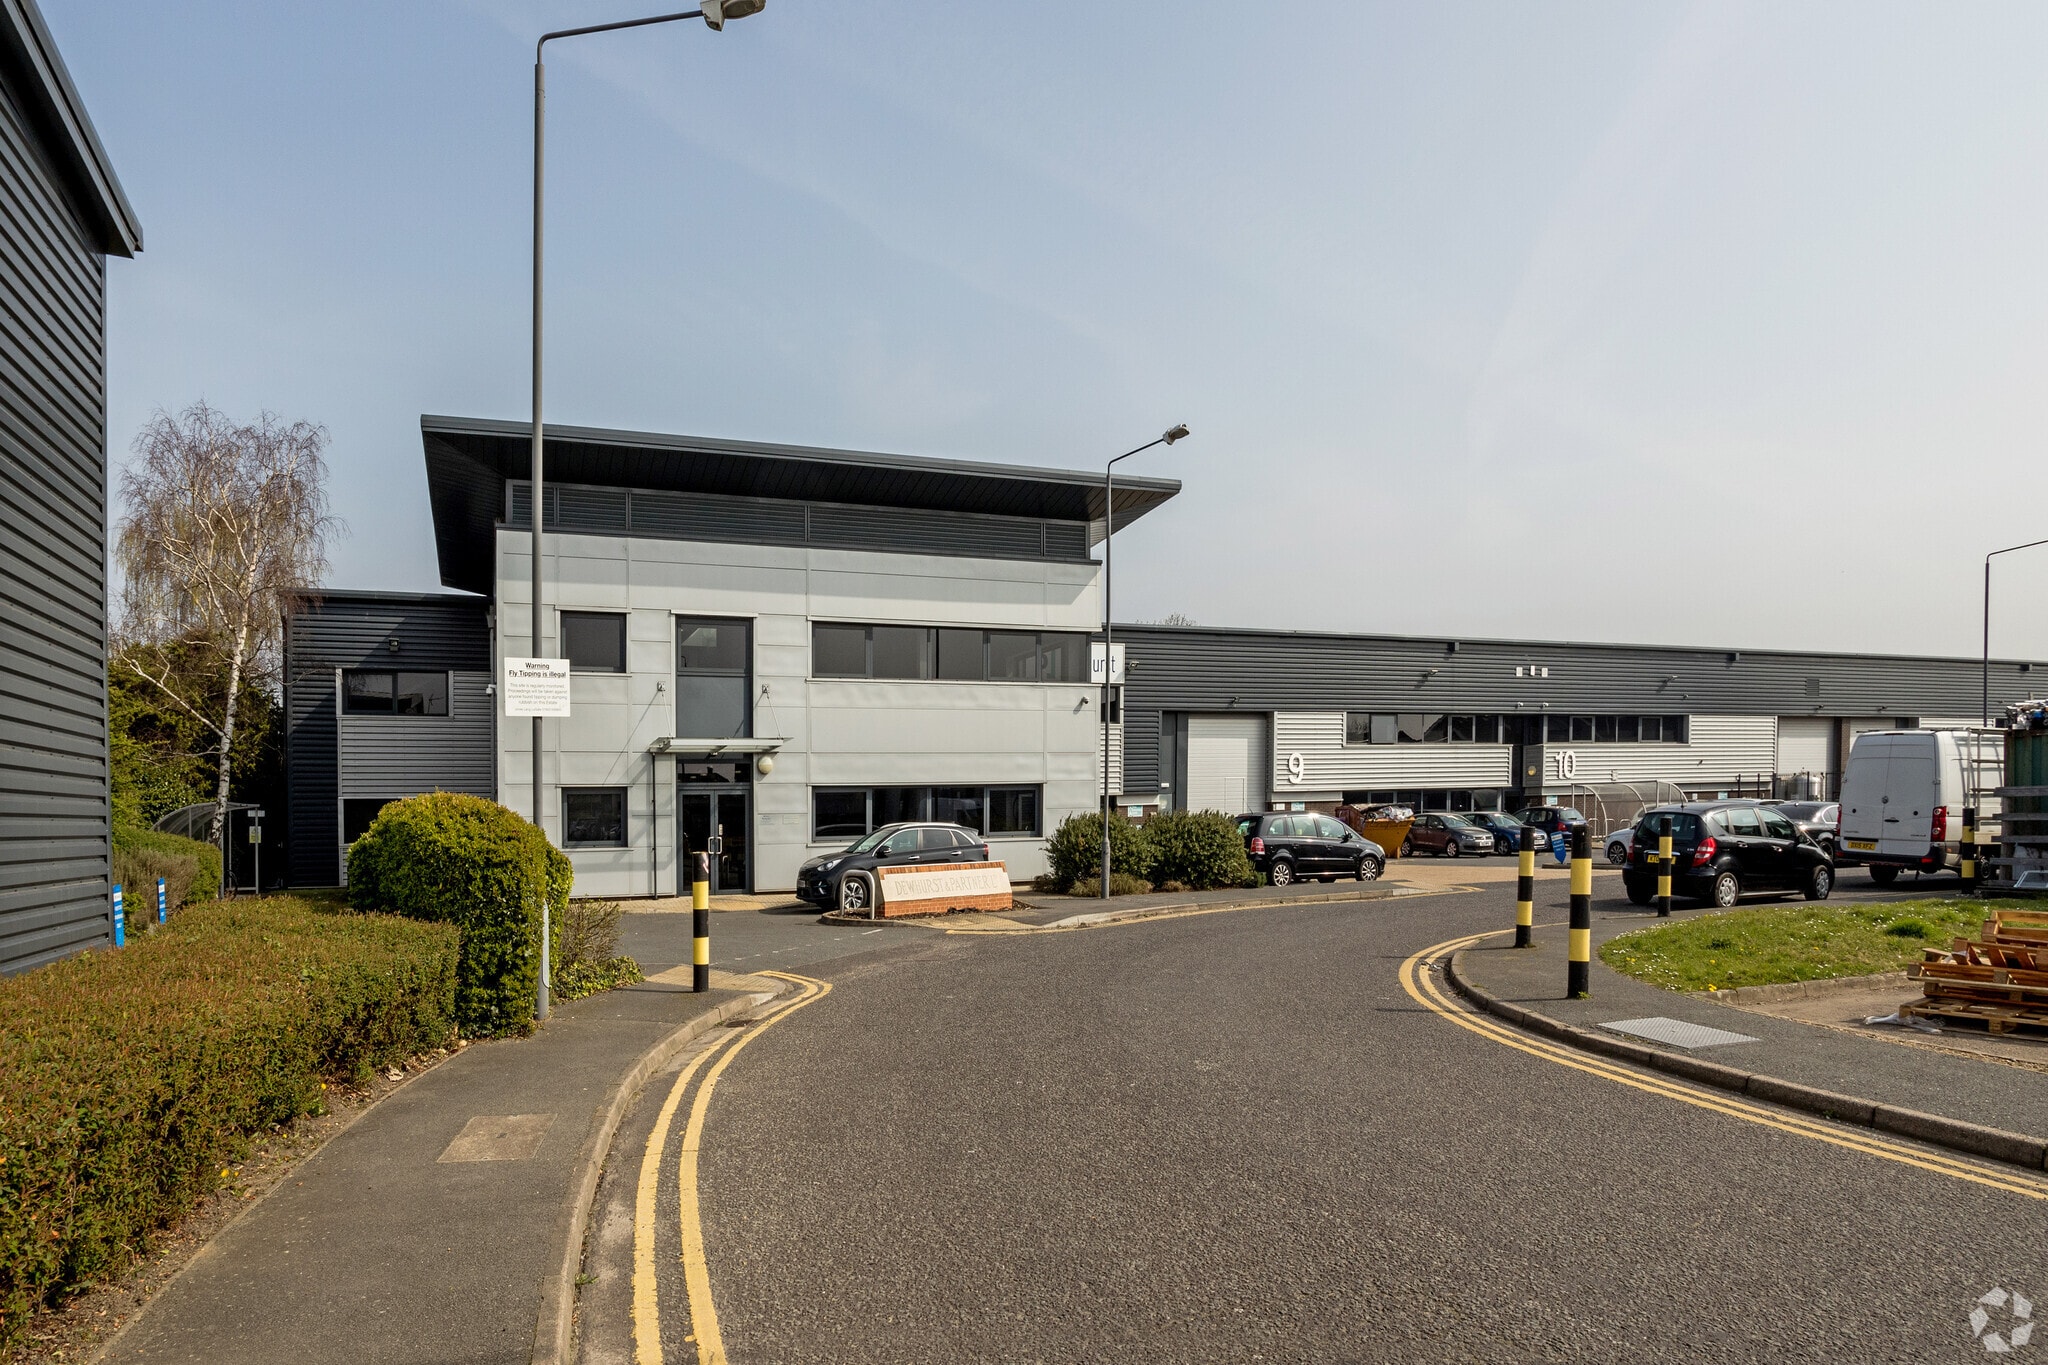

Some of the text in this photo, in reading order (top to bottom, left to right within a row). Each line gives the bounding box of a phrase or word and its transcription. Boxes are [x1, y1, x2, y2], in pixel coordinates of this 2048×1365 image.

[1093, 656, 1115, 673] urt
[1288, 752, 1304, 785] 9
[1555, 750, 1576, 779] 10
[894, 878, 944, 896] DEWHURST
[949, 875, 991, 892] PARTNER
